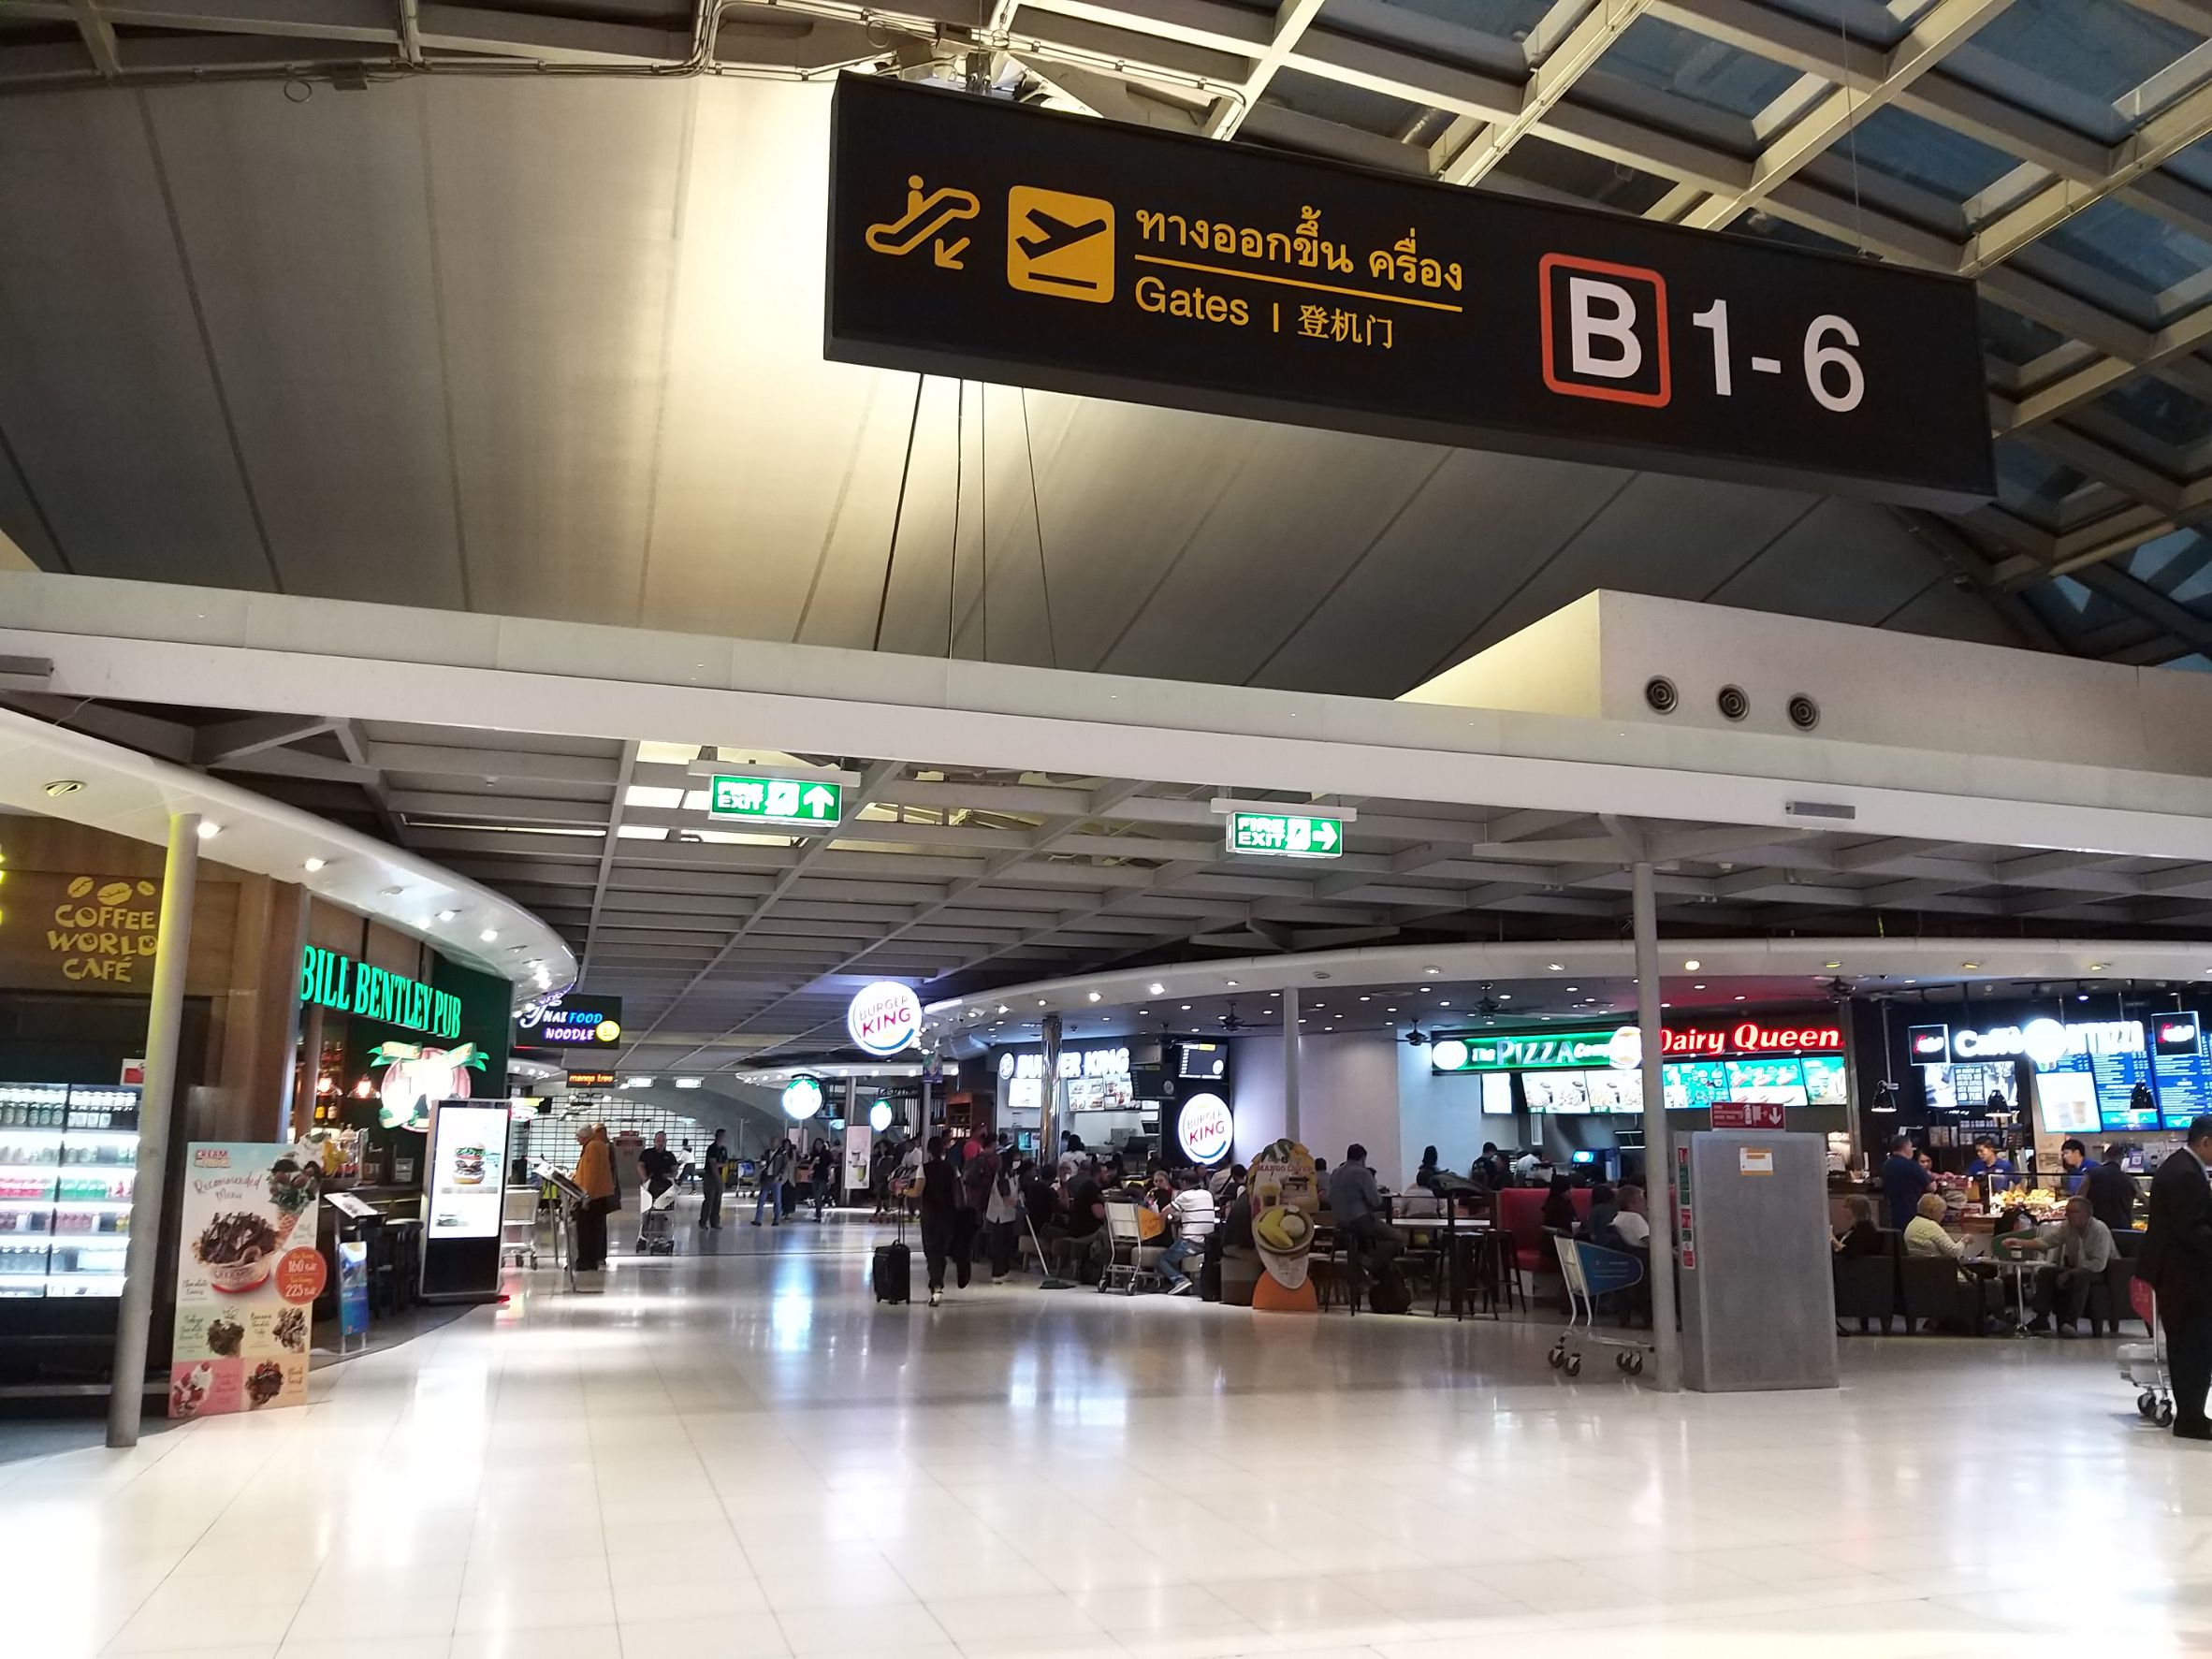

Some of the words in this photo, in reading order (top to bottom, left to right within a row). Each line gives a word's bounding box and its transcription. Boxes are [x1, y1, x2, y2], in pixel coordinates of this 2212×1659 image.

[1135, 205, 1354, 274] ทางออกขึ้น
[1368, 227, 1463, 293] ครื่อง
[1134, 276, 1250, 327] Gates
[1297, 304, 1393, 350] 登机门
[1569, 276, 1642, 379] B
[1237, 831, 1287, 848] EXIT
[54, 904, 156, 930] COFFEE
[47, 930, 158, 956] WORLD
[62, 955, 132, 982] CAFÉ
[300, 945, 350, 1010] BILL
[353, 962, 433, 1031] BENTLEY
[433, 990, 462, 1039] PUB
[569, 1012, 604, 1024] FOOD
[859, 996, 908, 1021] BURGER
[546, 1027, 595, 1041] NOODLE
[863, 1008, 911, 1039] KING
[1734, 1024, 1840, 1051] Queen
[1084, 1048, 1129, 1075] KING
[1497, 1038, 1578, 1066] PIZZA
[569, 1074, 595, 1085] mango
[1189, 1120, 1225, 1146] KING
[193, 1171, 263, 1194] Recommended
[214, 1187, 243, 1201] Menu
